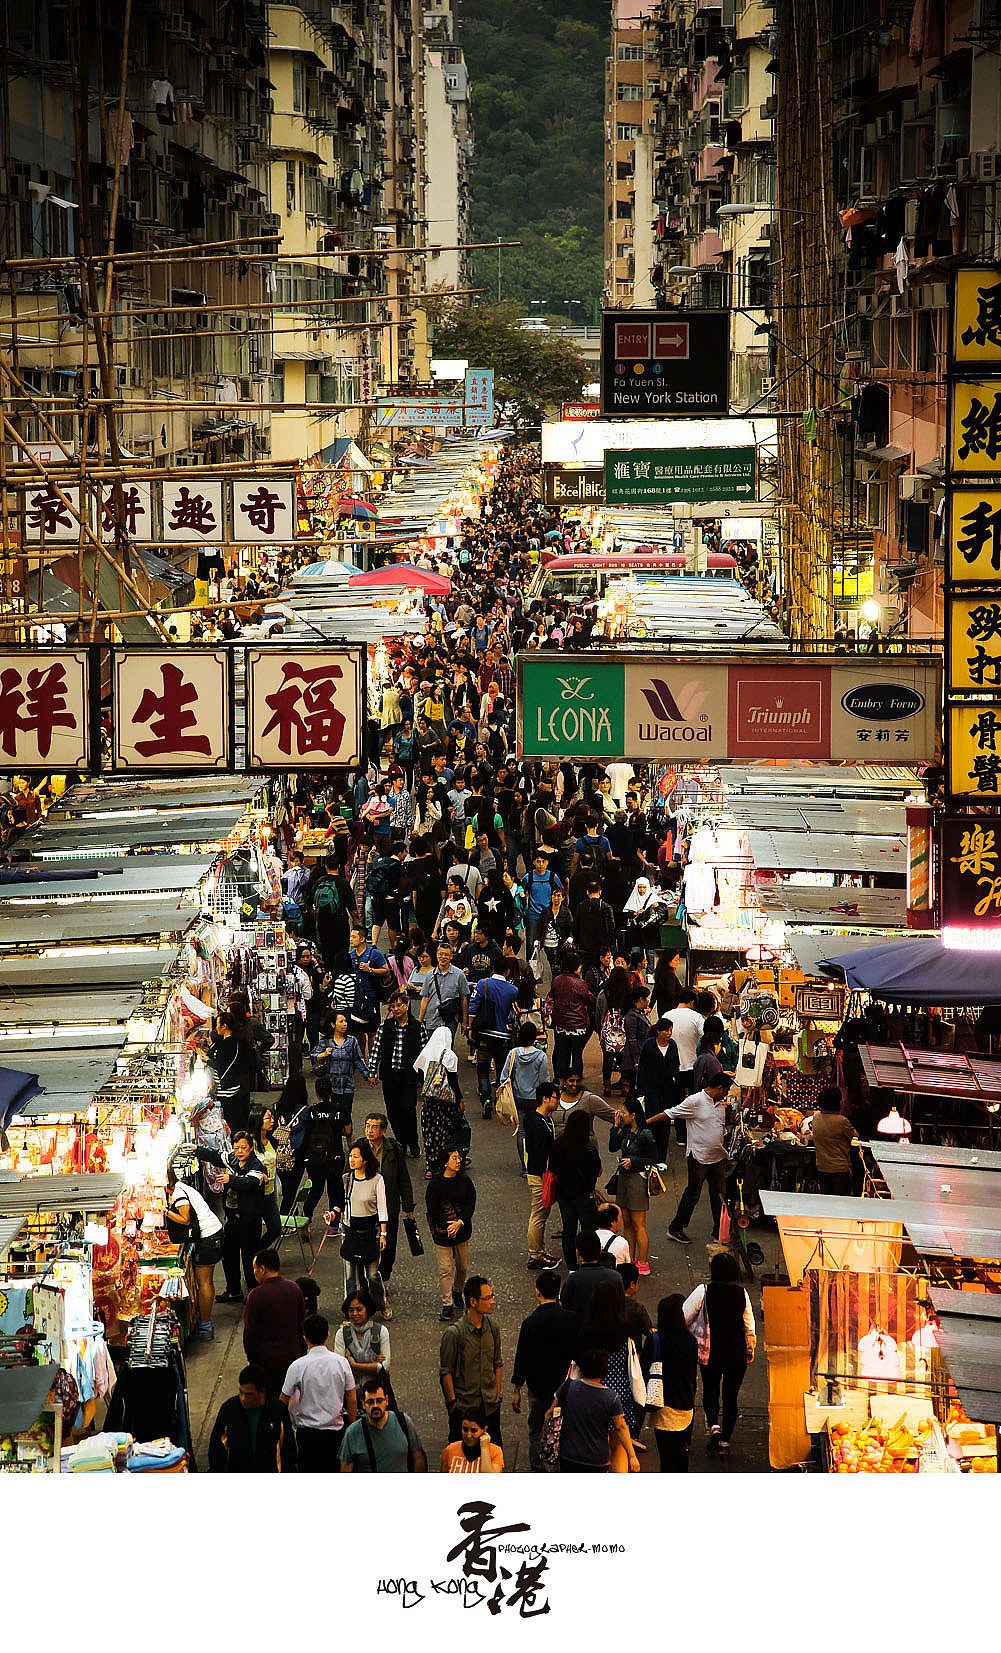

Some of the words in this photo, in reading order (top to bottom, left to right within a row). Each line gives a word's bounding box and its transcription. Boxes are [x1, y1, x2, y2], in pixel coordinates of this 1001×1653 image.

[618, 335, 648, 344] ENTRY
[613, 378, 626, 387] Fa
[629, 378, 654, 387] Yuen
[613, 392, 640, 404] New
[644, 391, 672, 404] York
[675, 391, 718, 404] Station
[850, 698, 884, 711] Embry
[890, 698, 917, 709] Form
[747, 706, 811, 727] Triumph
[537, 707, 613, 743] LEONA
[638, 723, 712, 742] Wacoal
[856, 729, 910, 742] 安莉芳
